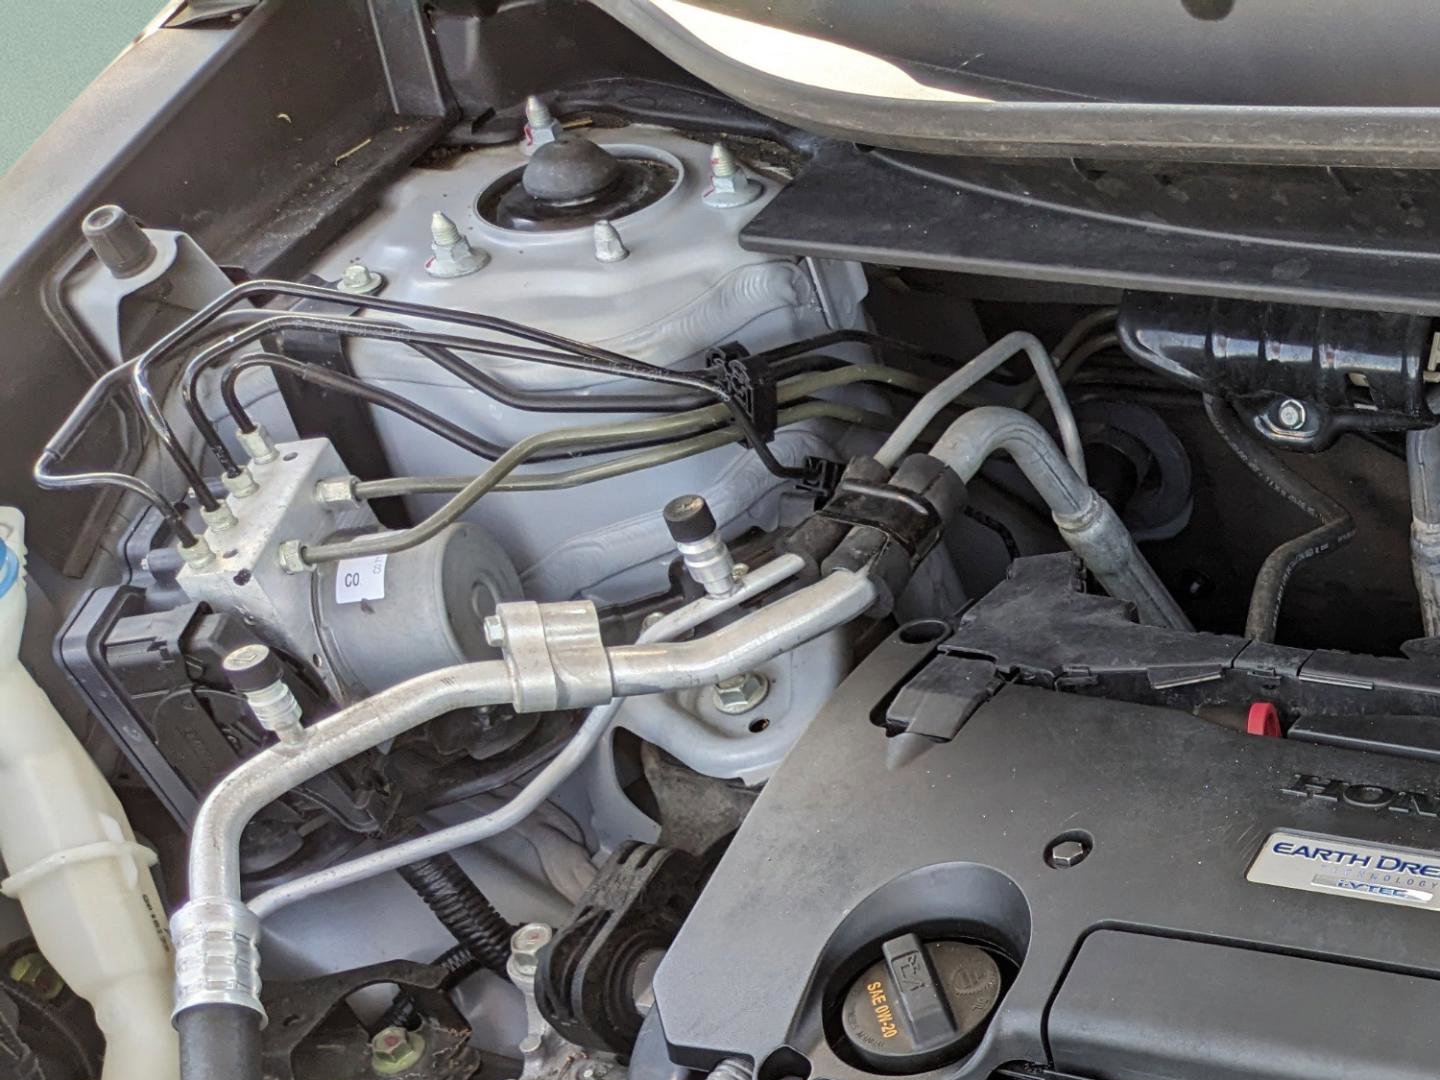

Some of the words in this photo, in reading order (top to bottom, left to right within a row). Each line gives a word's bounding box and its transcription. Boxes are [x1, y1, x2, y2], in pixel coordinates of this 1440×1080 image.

[1272, 841, 1371, 869] EARTH
[867, 981, 887, 1006] SAE
[875, 1005, 898, 1038] 0W-20
